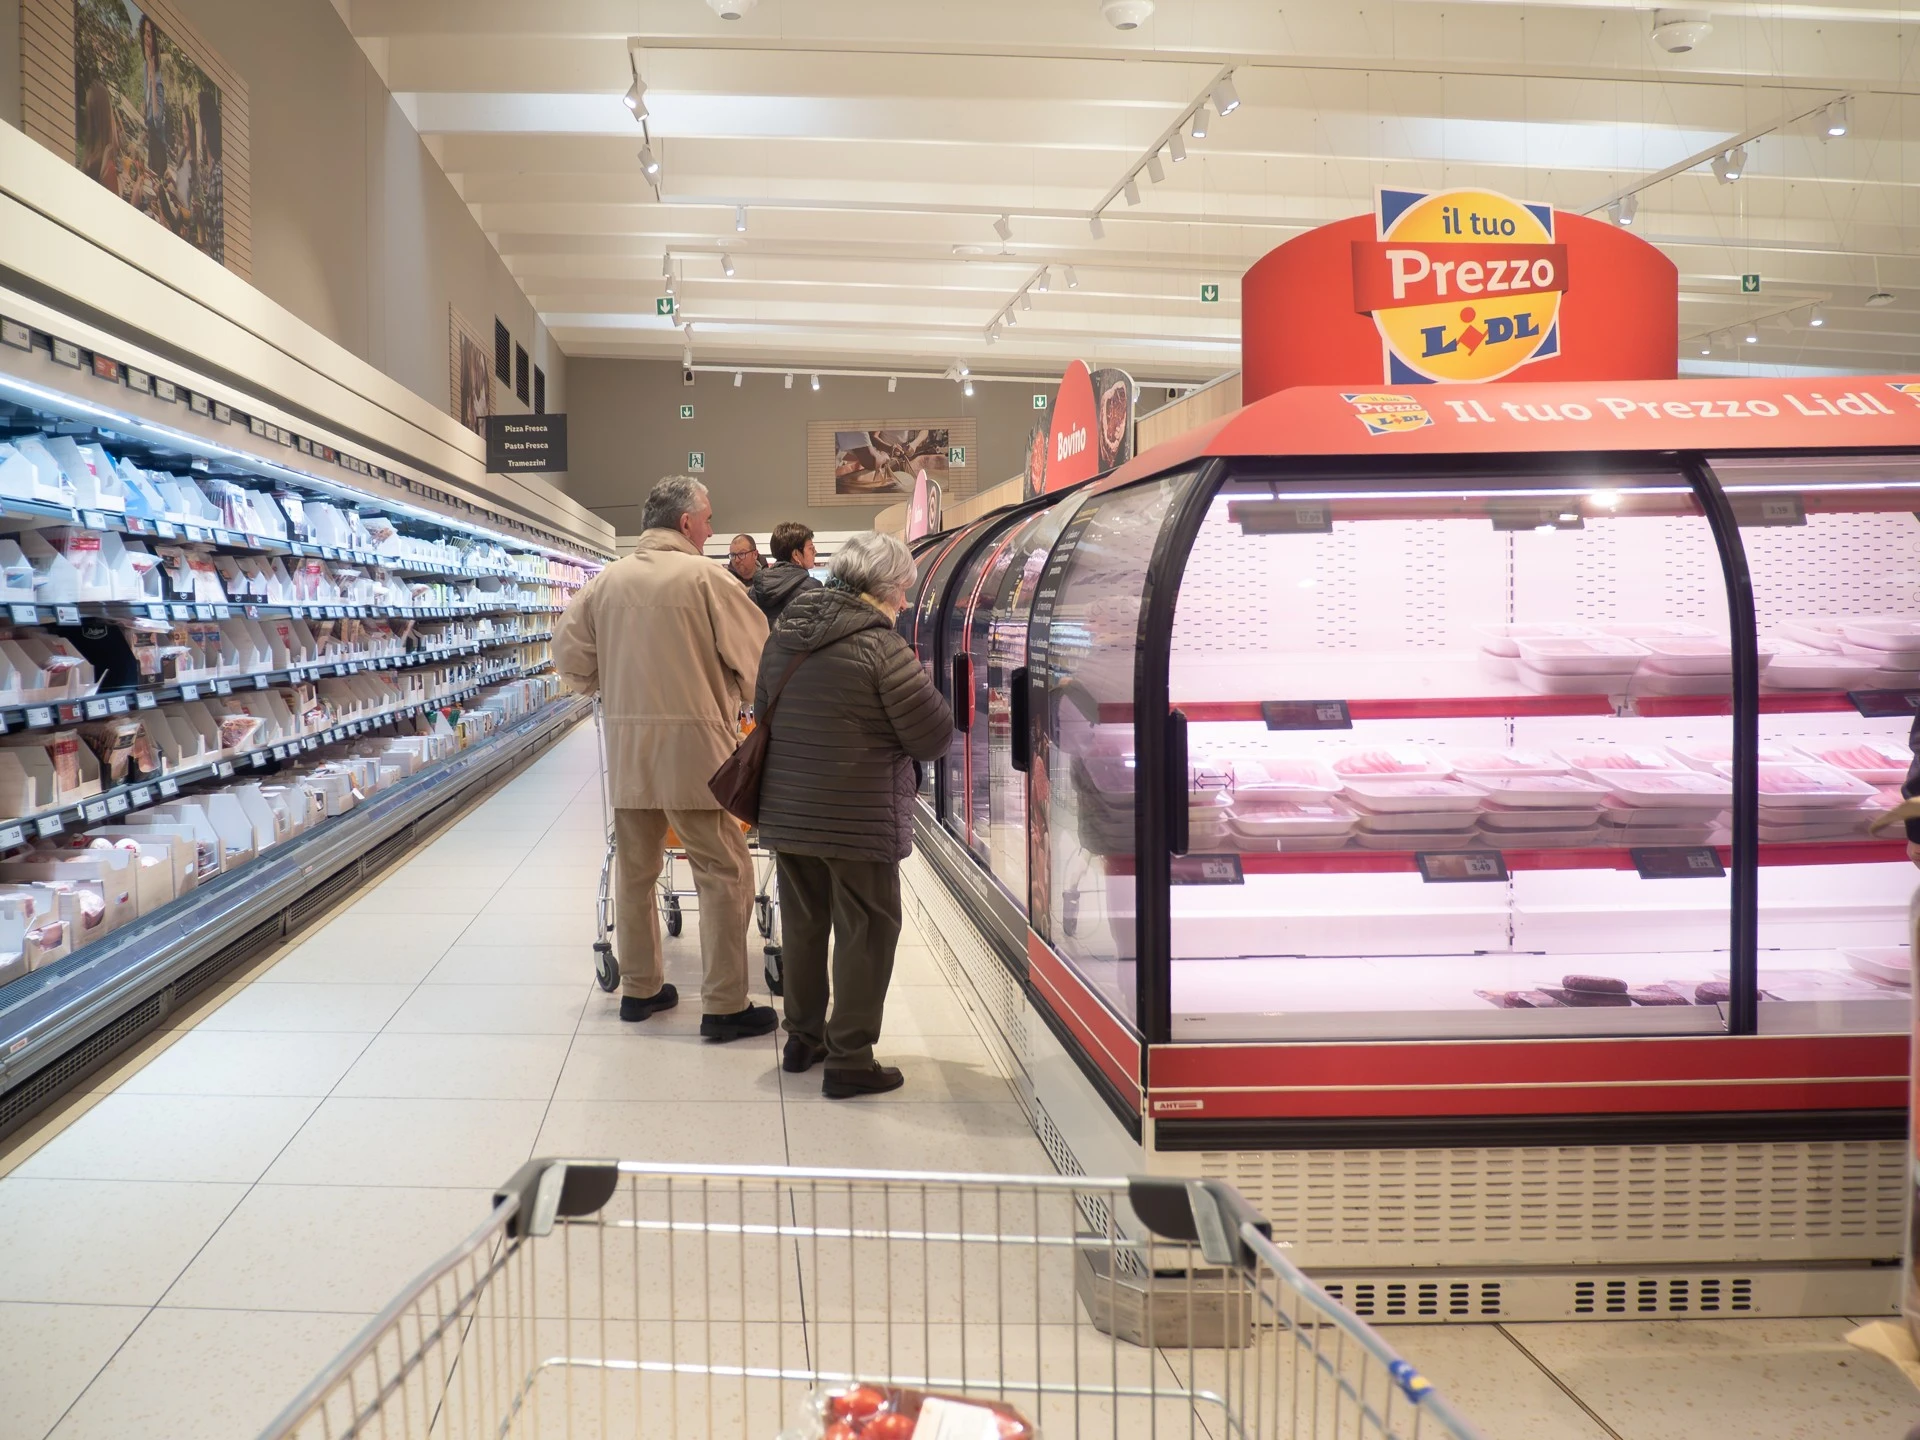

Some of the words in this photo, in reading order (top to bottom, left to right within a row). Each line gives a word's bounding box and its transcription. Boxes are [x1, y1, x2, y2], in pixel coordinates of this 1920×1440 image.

[1442, 206, 1462, 234] il
[1469, 213, 1516, 236] tuo
[1385, 249, 1555, 299] Prezzo
[1353, 403, 1422, 413] Prezzo
[1444, 400, 1496, 422] Il
[1501, 402, 1592, 421] tuo
[1596, 397, 1780, 419] Prezzo
[1782, 392, 1896, 416] Lidl
[504, 425, 524, 433] Pizza
[504, 442, 525, 450] Pasta
[1057, 421, 1087, 462] Bovino
[508, 459, 546, 467] Tramezzini
